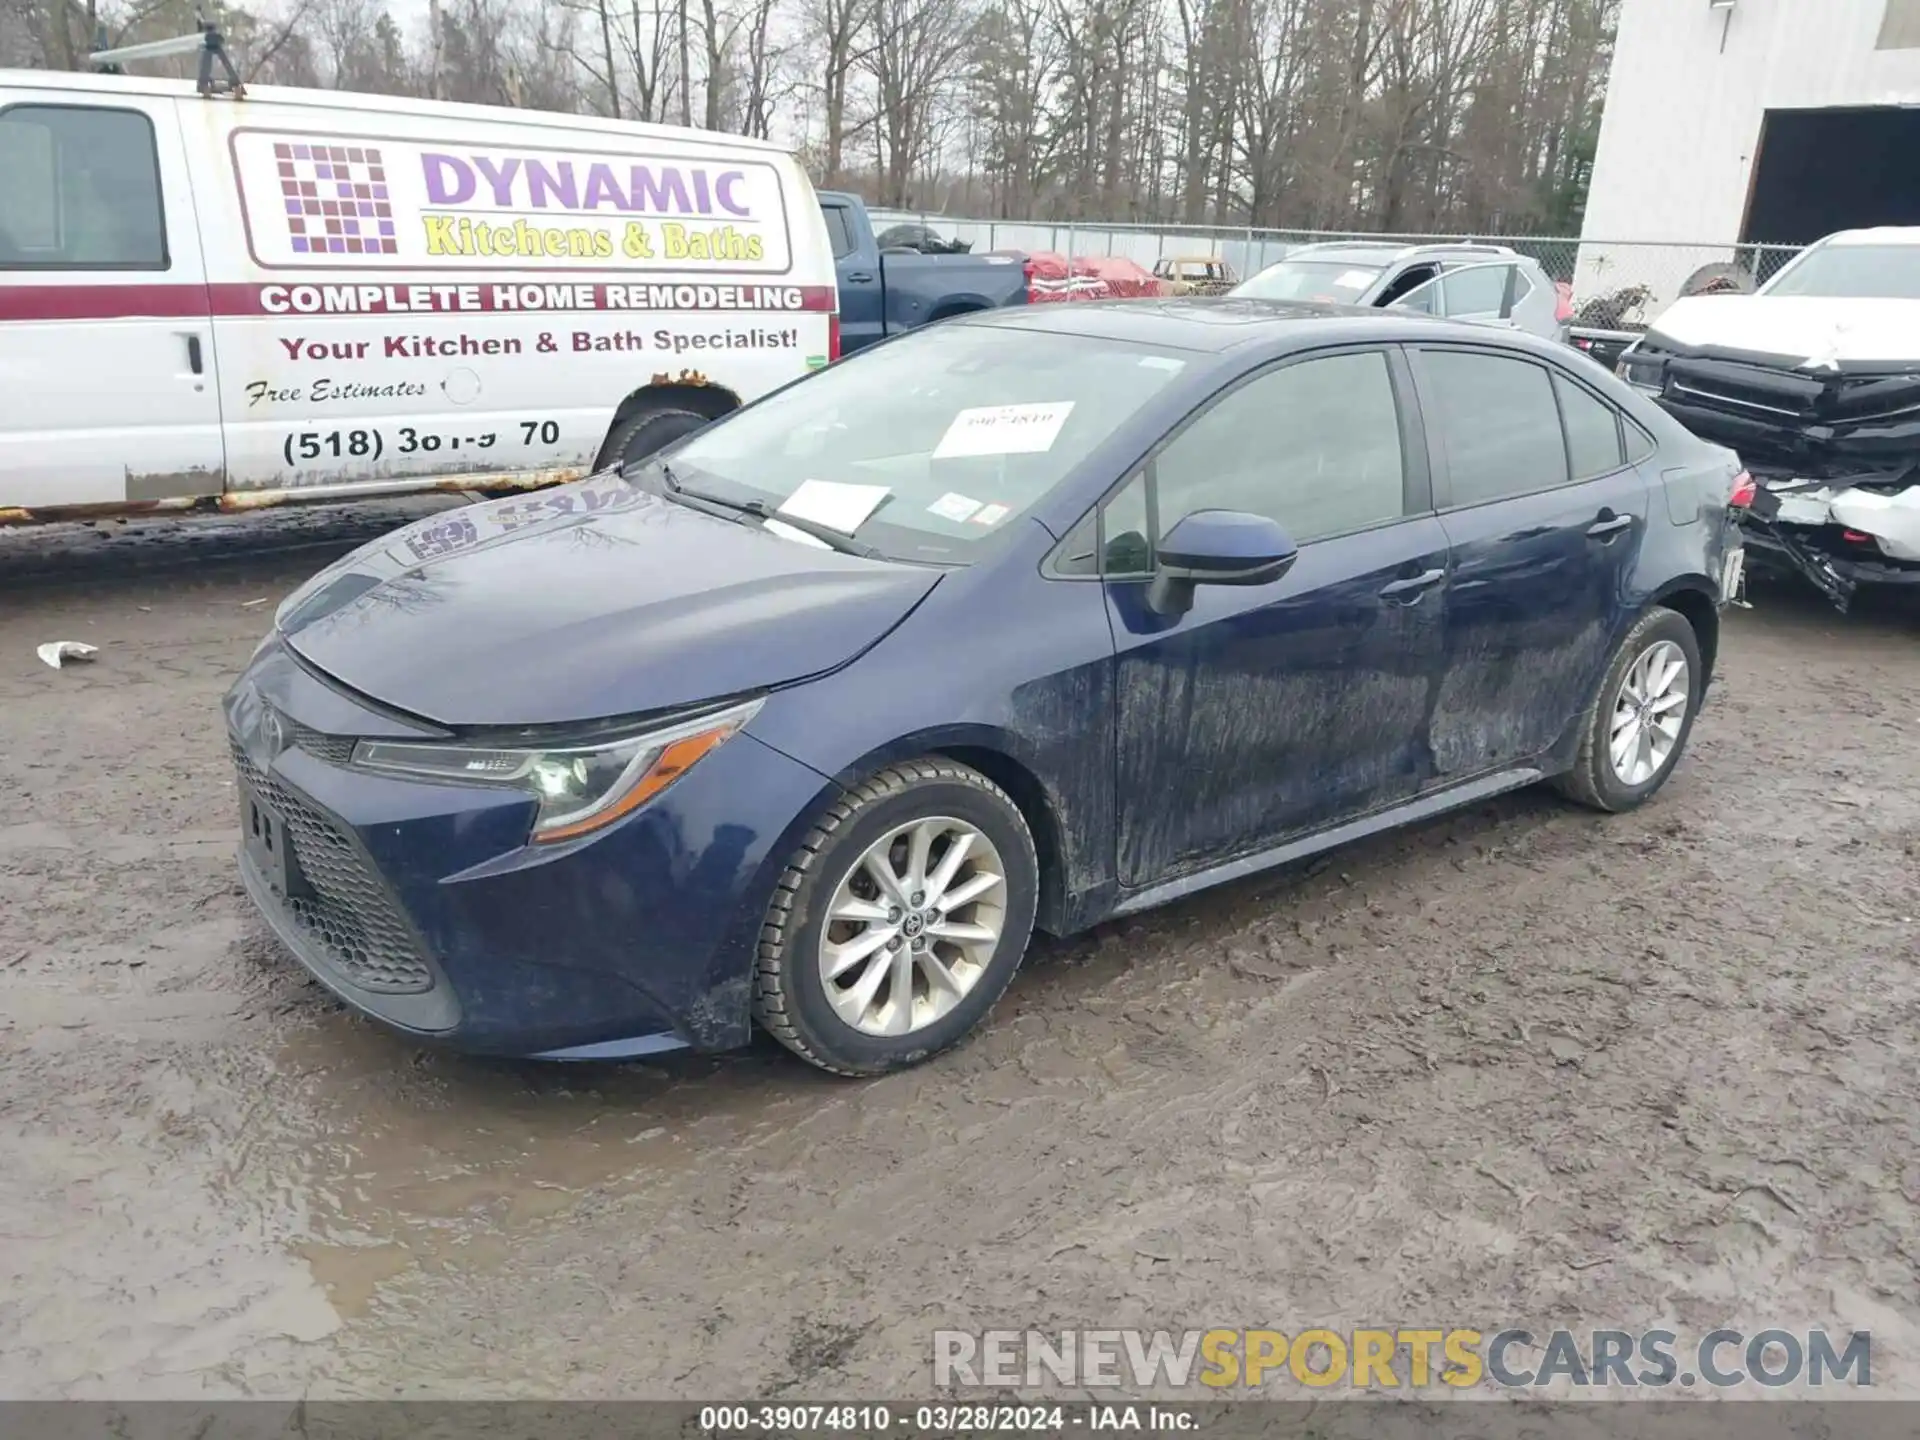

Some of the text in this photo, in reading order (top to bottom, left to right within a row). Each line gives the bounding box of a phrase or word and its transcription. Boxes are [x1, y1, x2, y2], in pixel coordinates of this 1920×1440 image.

[420, 152, 750, 216] DYNAMIC
[422, 215, 764, 262] Kitchens & Baths
[259, 285, 803, 313] COMPLETE HOME REMODELING
[279, 328, 799, 361] Your Kitchen & Bath Specialist!
[244, 378, 427, 407] Free Estimates
[283, 428, 383, 466] (518)
